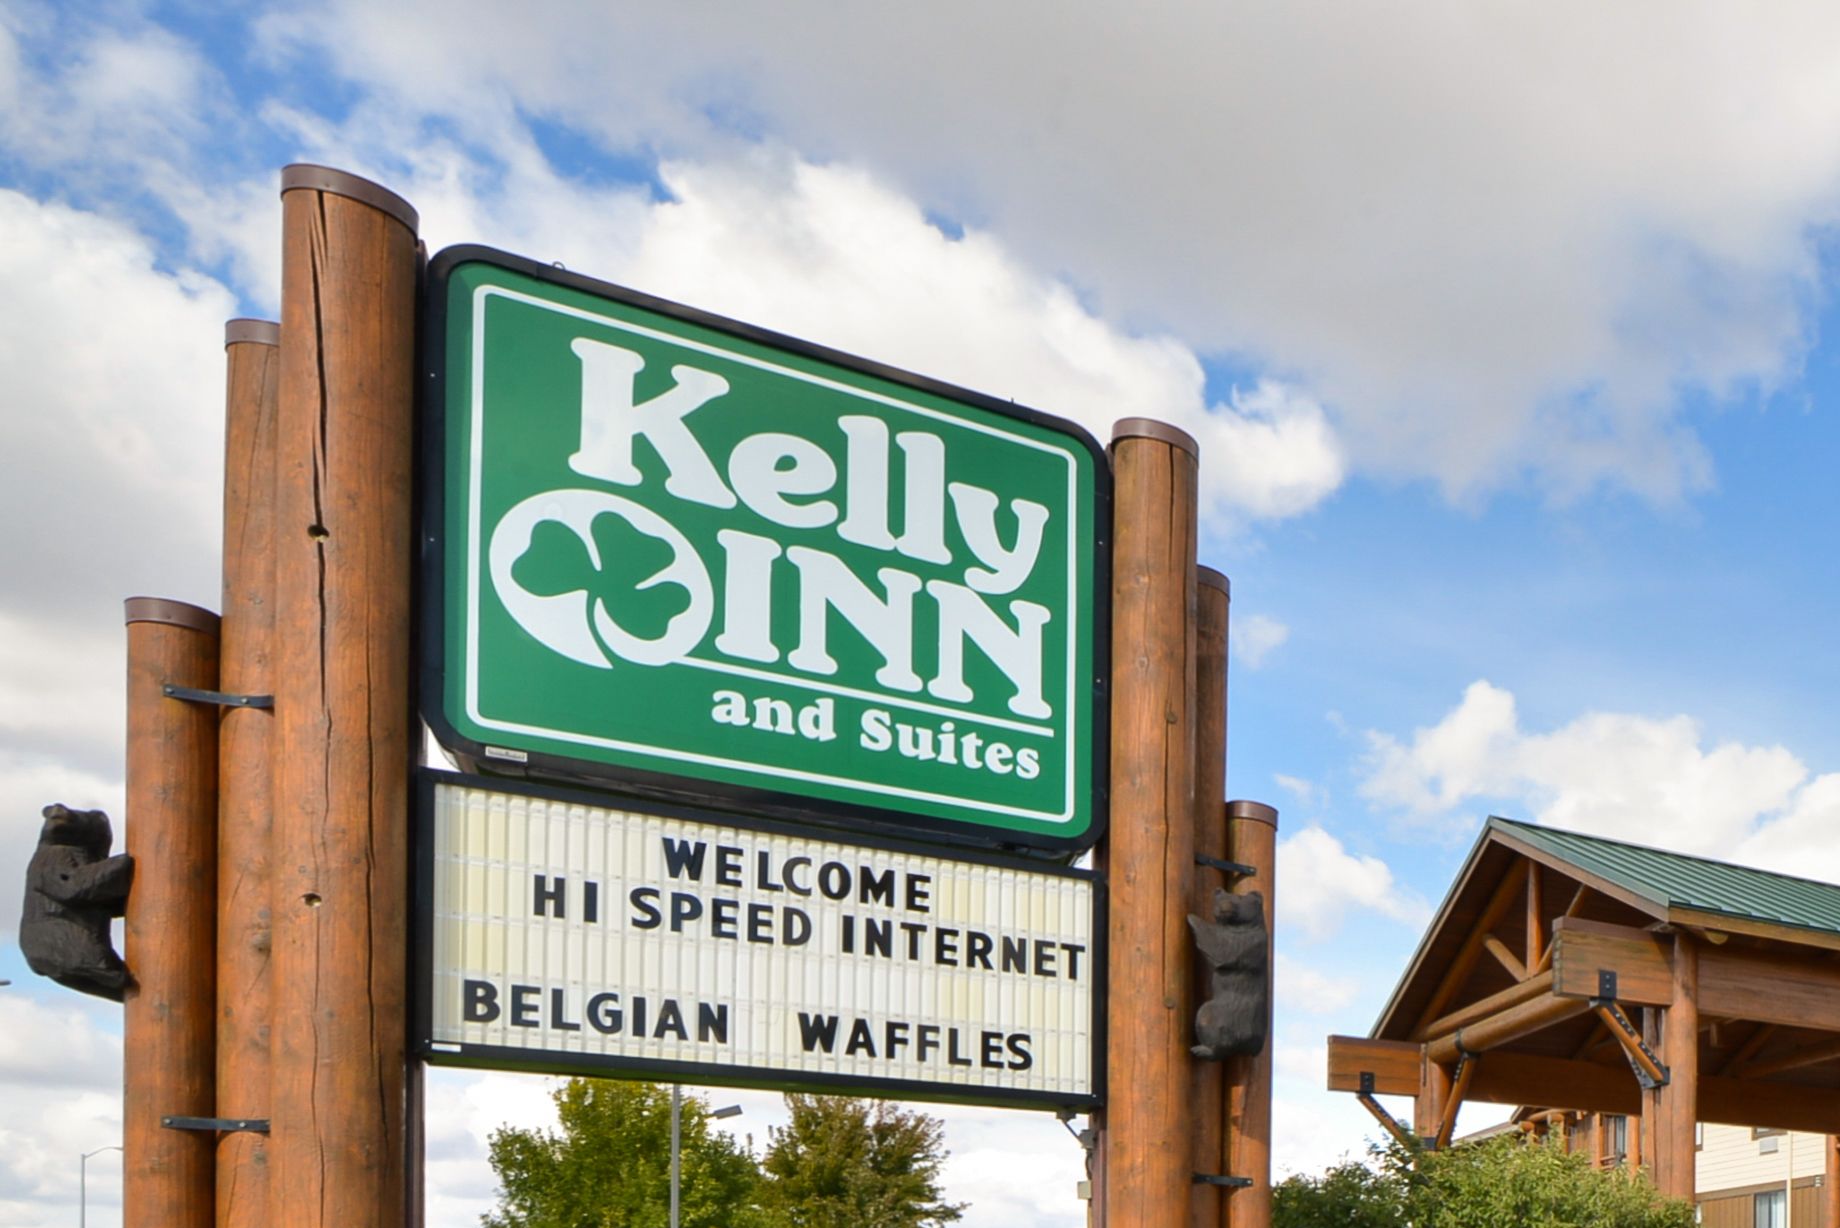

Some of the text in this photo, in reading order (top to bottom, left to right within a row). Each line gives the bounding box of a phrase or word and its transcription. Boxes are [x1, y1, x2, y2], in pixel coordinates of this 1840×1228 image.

[567, 336, 1050, 596] Kelly
[714, 528, 1053, 720] INN
[711, 689, 1041, 780] and Suites
[661, 836, 932, 914] WELCOME
[533, 873, 1087, 982] HI SPEED INTERNET
[463, 978, 1034, 1072] BELGIAN WAFFLES
